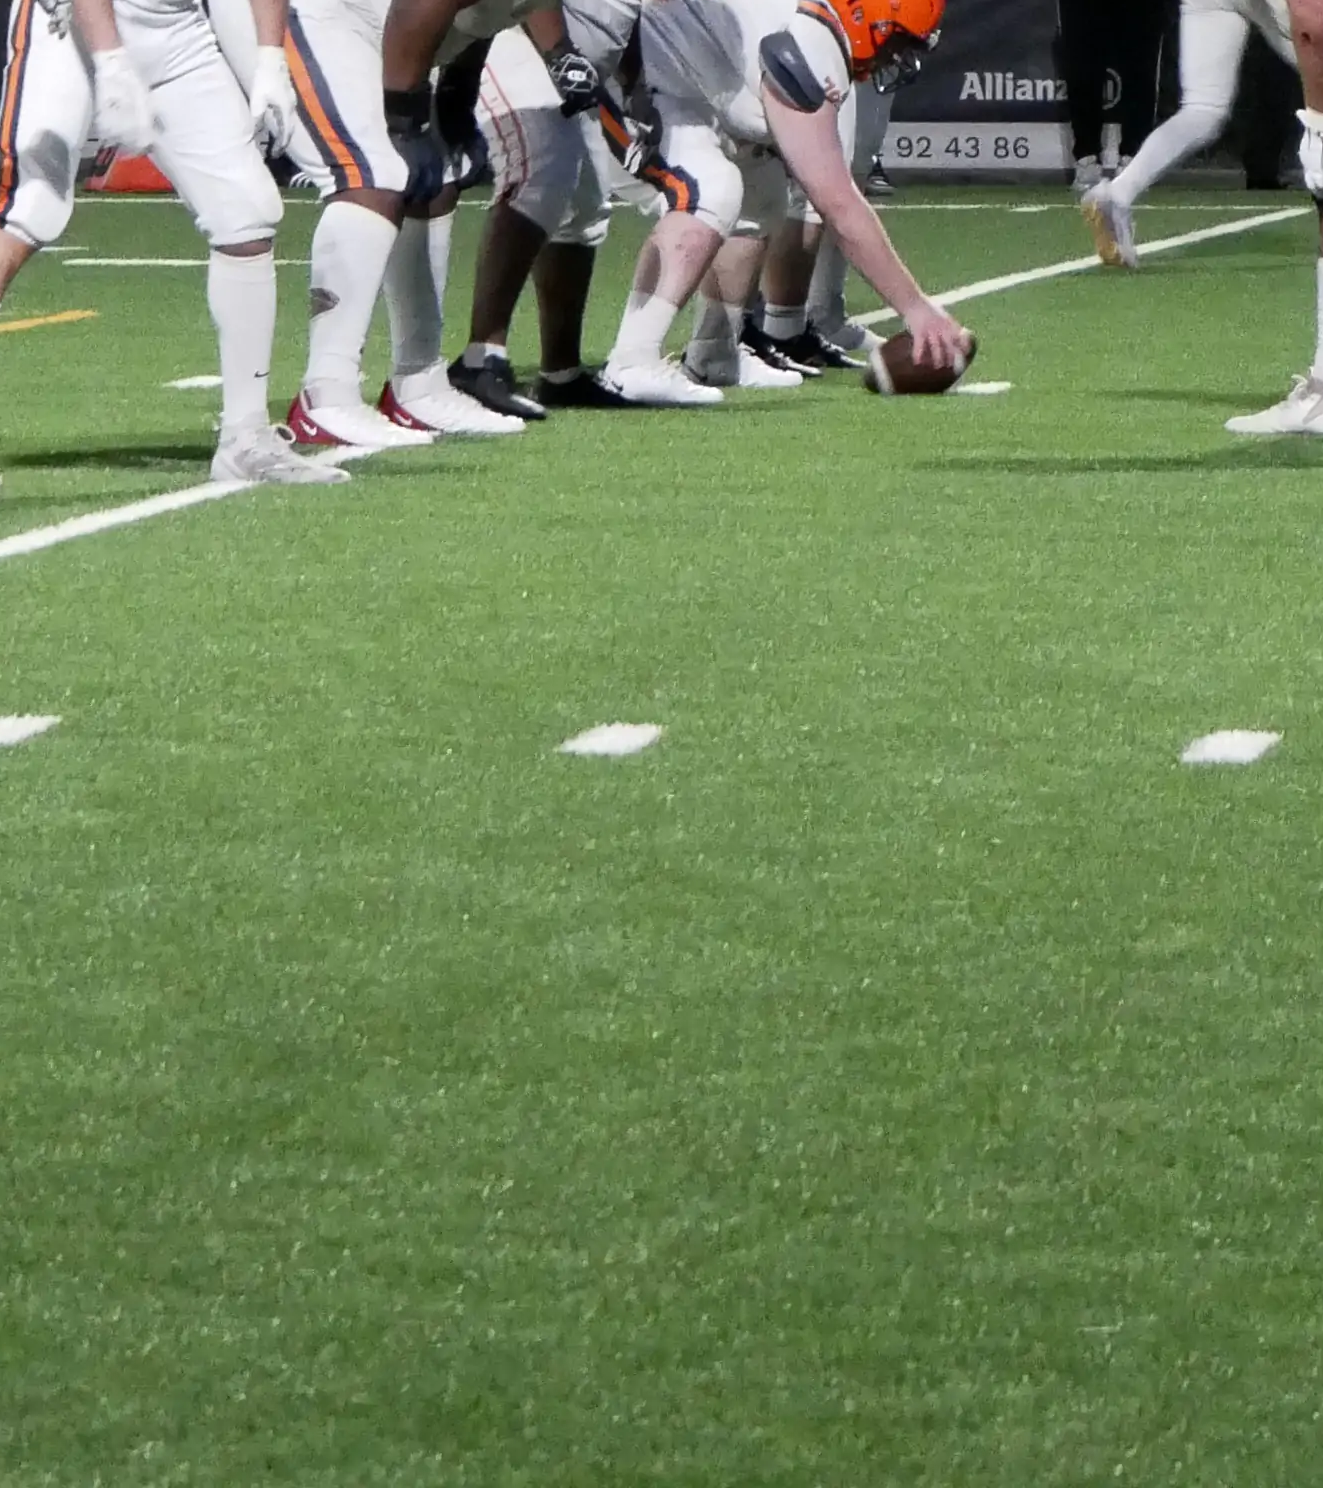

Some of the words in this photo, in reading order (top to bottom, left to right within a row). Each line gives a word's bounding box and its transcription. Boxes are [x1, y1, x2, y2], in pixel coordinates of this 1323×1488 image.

[958, 71, 1069, 101] Allianz
[896, 136, 932, 158] 92
[945, 136, 980, 158] 43
[994, 136, 1030, 158] 86
